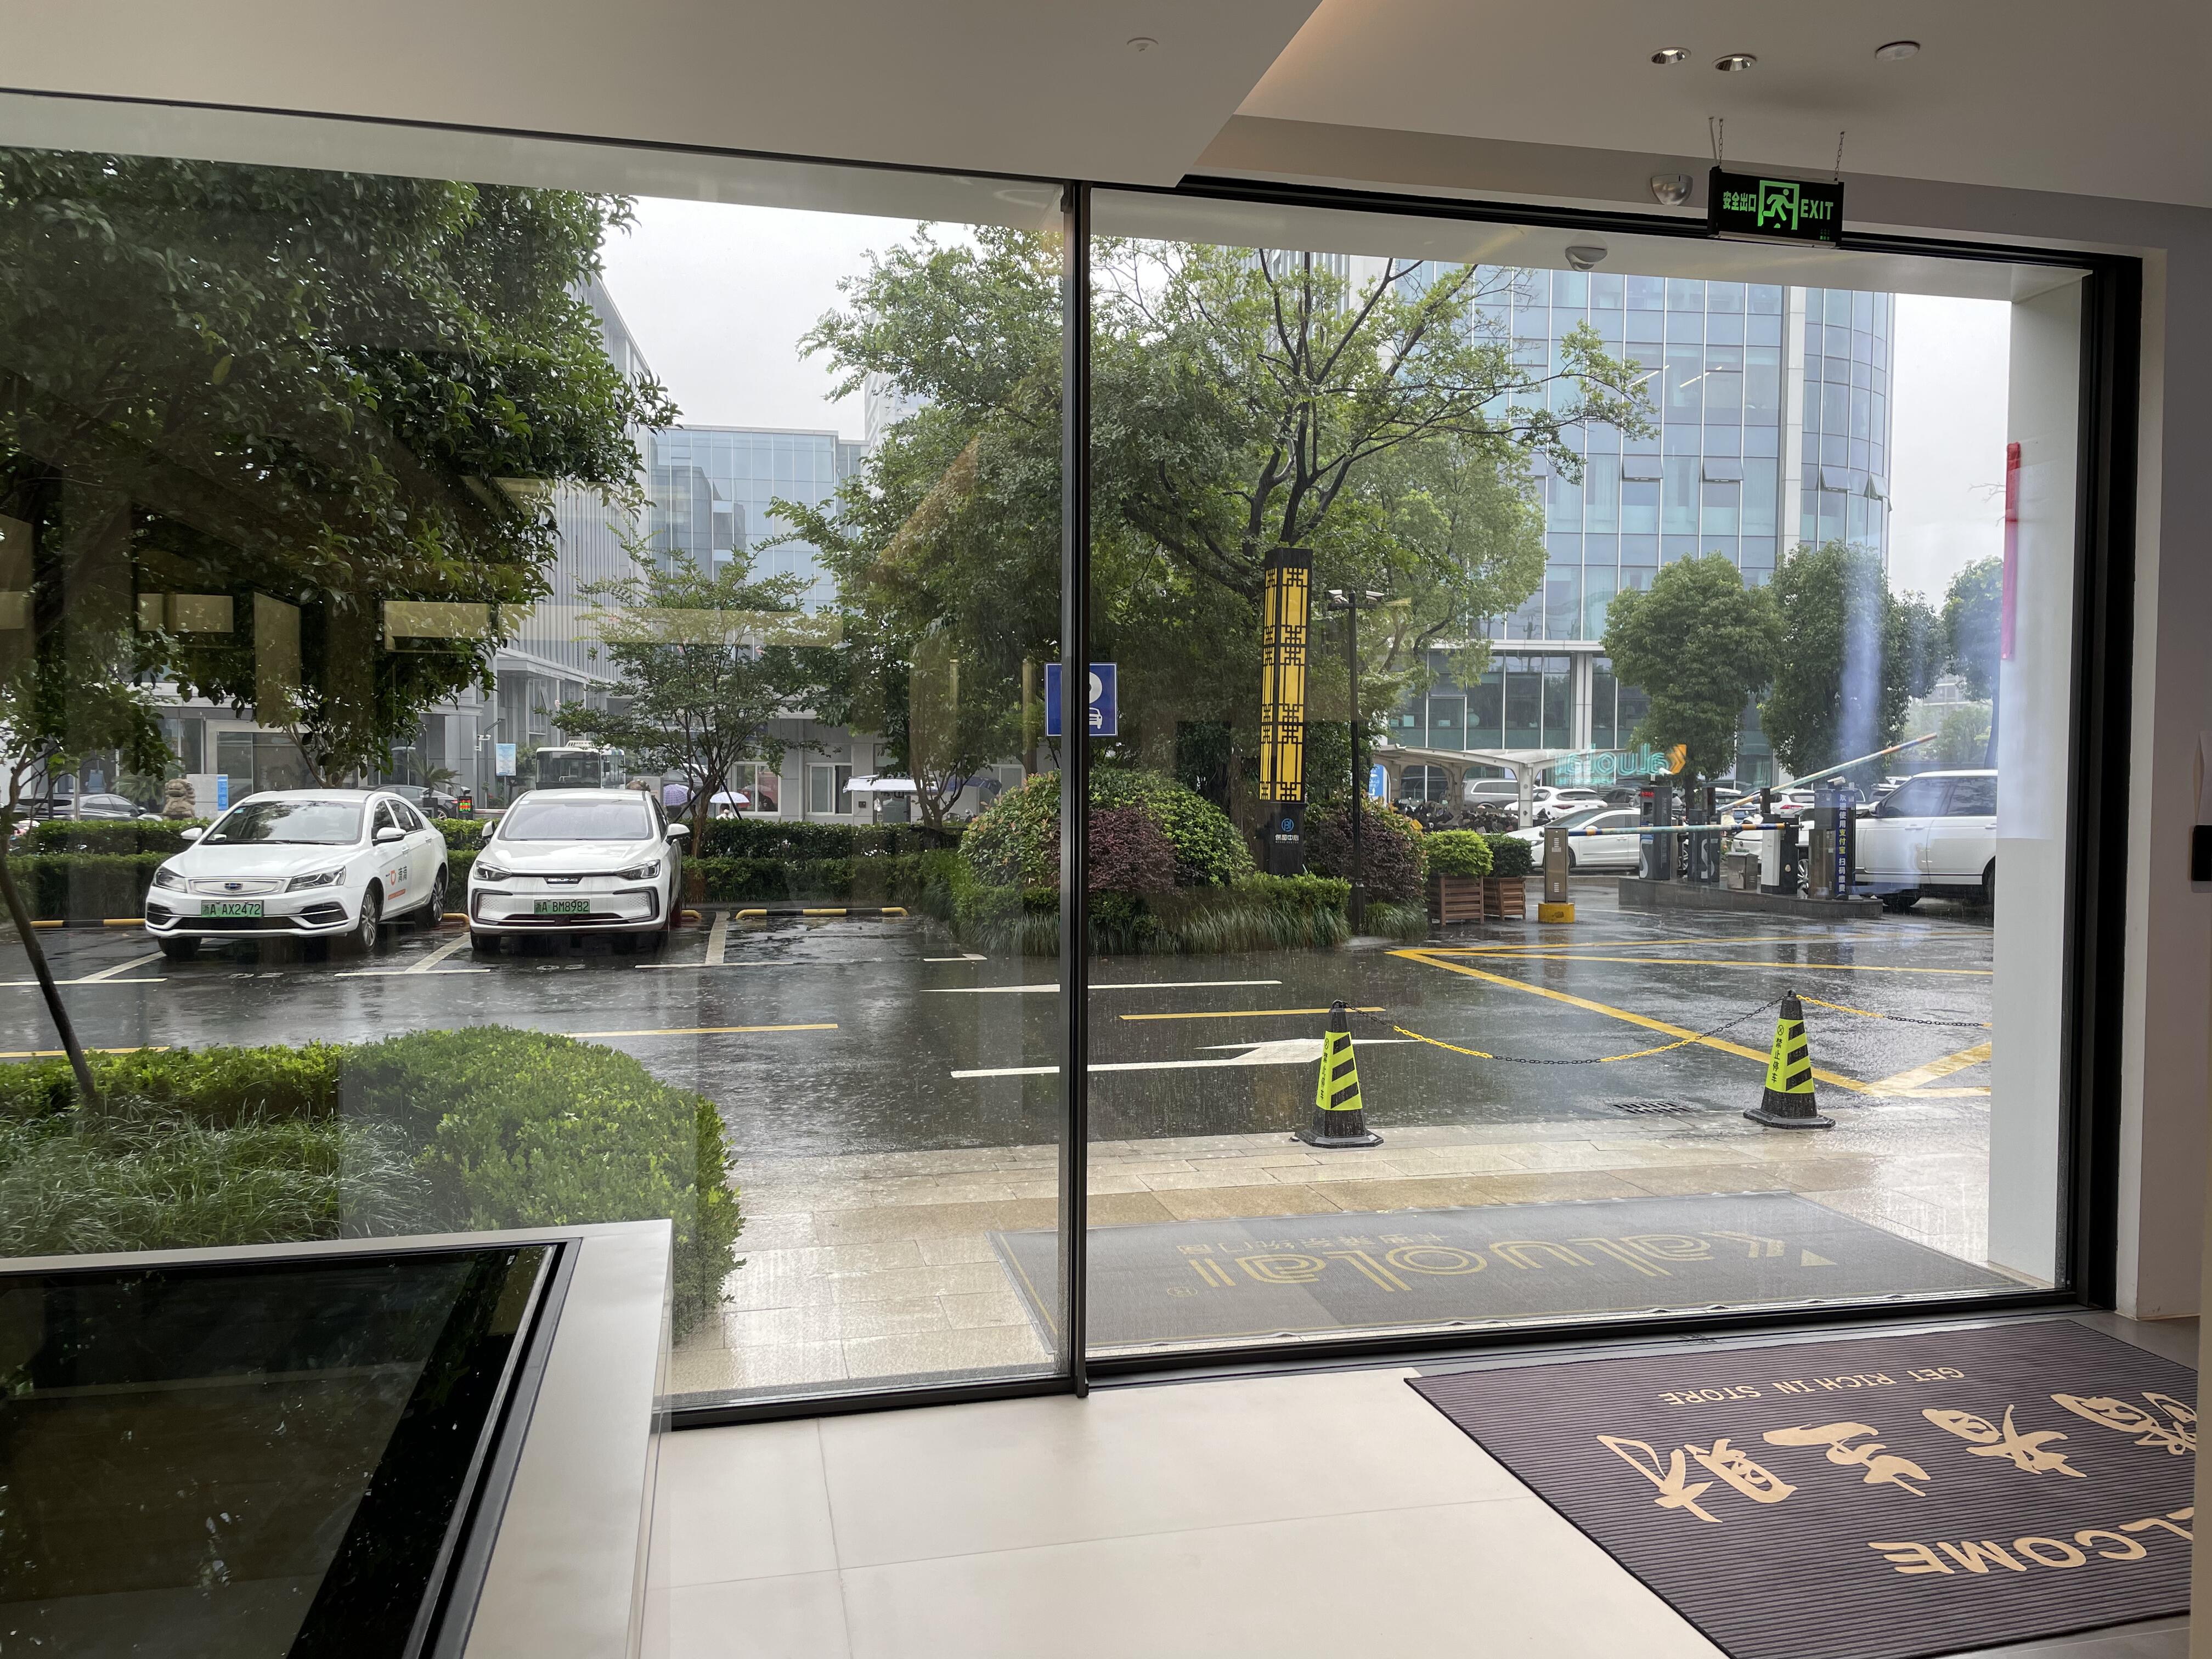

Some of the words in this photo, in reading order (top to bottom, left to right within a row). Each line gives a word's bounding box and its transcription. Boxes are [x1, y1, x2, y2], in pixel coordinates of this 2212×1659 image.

[1723, 191, 1756, 212] 安全出口
[1801, 199, 1833, 220] EXIT
[1771, 1038, 1782, 1083] 禁止停车
[1814, 1373, 1897, 1391] RICH
[1906, 1367, 1965, 1382] GET
[1658, 1385, 1761, 1405] STORE
[1771, 1380, 1810, 1395] IN
[1867, 1507, 2194, 1574] LCOME
